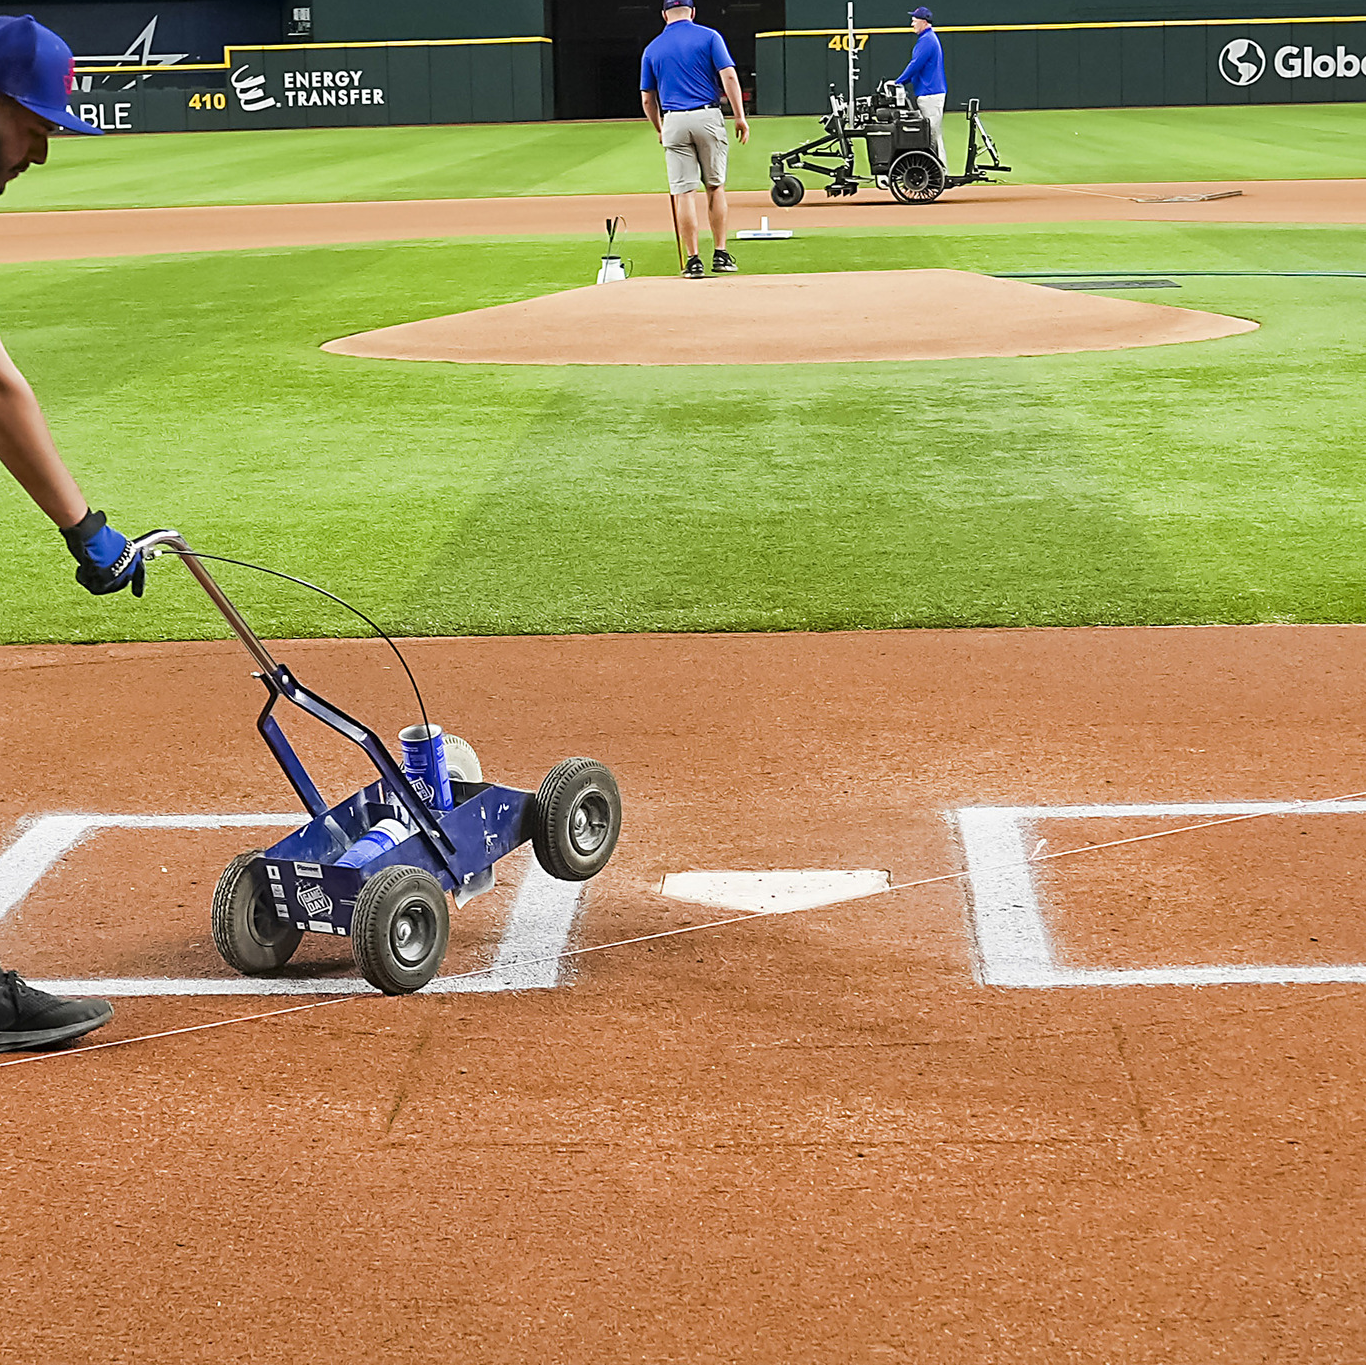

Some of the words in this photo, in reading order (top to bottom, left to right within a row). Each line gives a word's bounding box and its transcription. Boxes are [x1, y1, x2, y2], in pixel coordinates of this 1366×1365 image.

[283, 70, 363, 89] ENERGY
[189, 93, 226, 110] 410
[284, 88, 385, 106] TRANSFER
[302, 888, 322, 903] GAME
[307, 898, 326, 913] DAY
